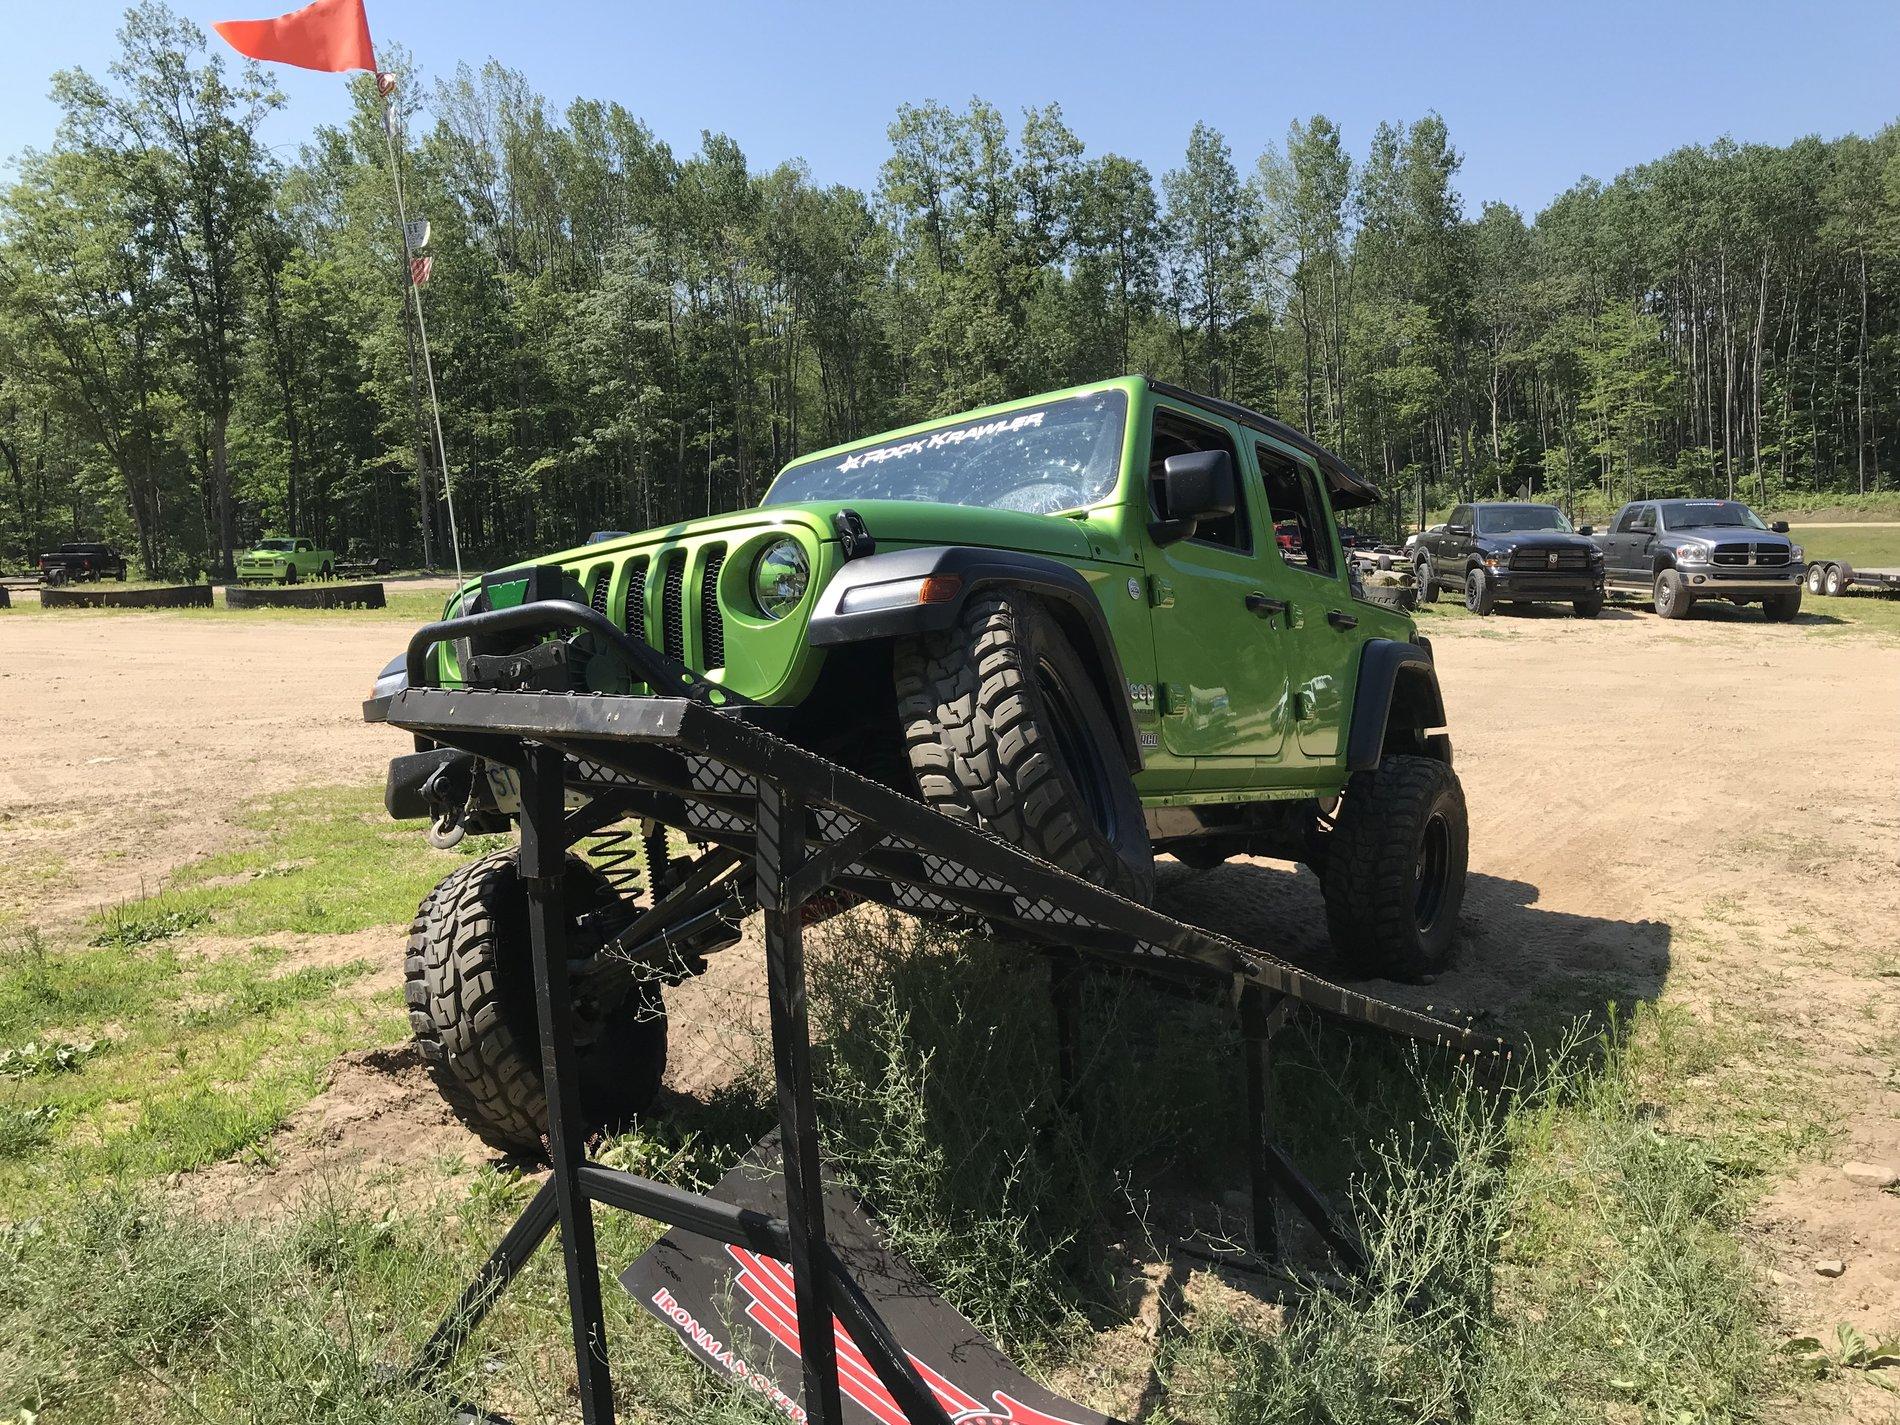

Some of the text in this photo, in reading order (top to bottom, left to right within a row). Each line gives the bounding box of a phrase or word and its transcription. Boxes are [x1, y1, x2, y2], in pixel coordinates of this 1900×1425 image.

[861, 412, 1045, 468] ROCK KRAWLER
[1126, 678, 1155, 705] eep
[651, 1287, 750, 1379] IRONMAN
